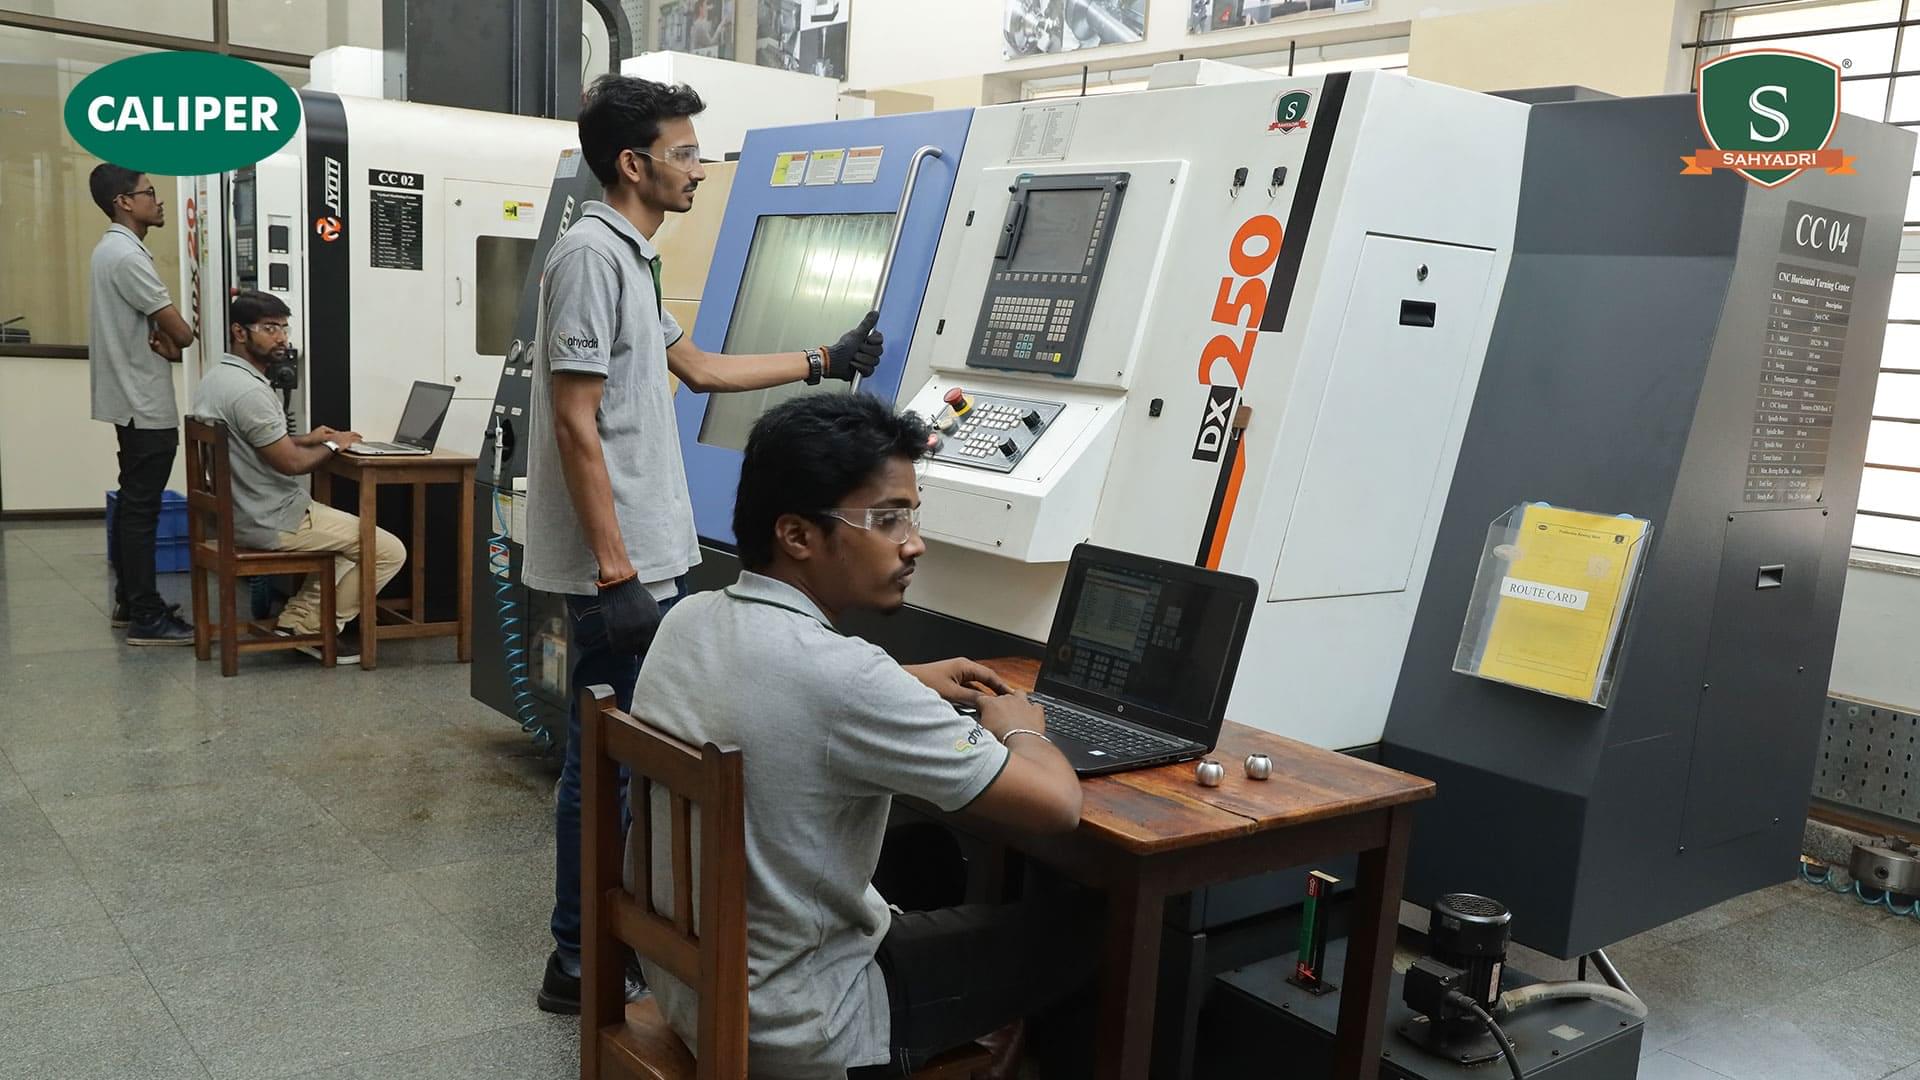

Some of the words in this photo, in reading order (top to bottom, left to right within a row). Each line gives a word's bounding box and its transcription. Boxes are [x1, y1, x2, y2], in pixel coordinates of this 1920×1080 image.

[1285, 101, 1298, 120] S
[325, 156, 341, 218] JYOTI
[378, 172, 398, 185] CC
[400, 174, 415, 186] 02
[1796, 213, 1827, 248] CC
[1828, 220, 1850, 253] 04
[1779, 272, 1791, 282] CNC
[1197, 214, 1283, 390] 250
[1198, 398, 1232, 453] DX
[1510, 583, 1545, 599] ROUTE
[1546, 589, 1578, 604] CARD
